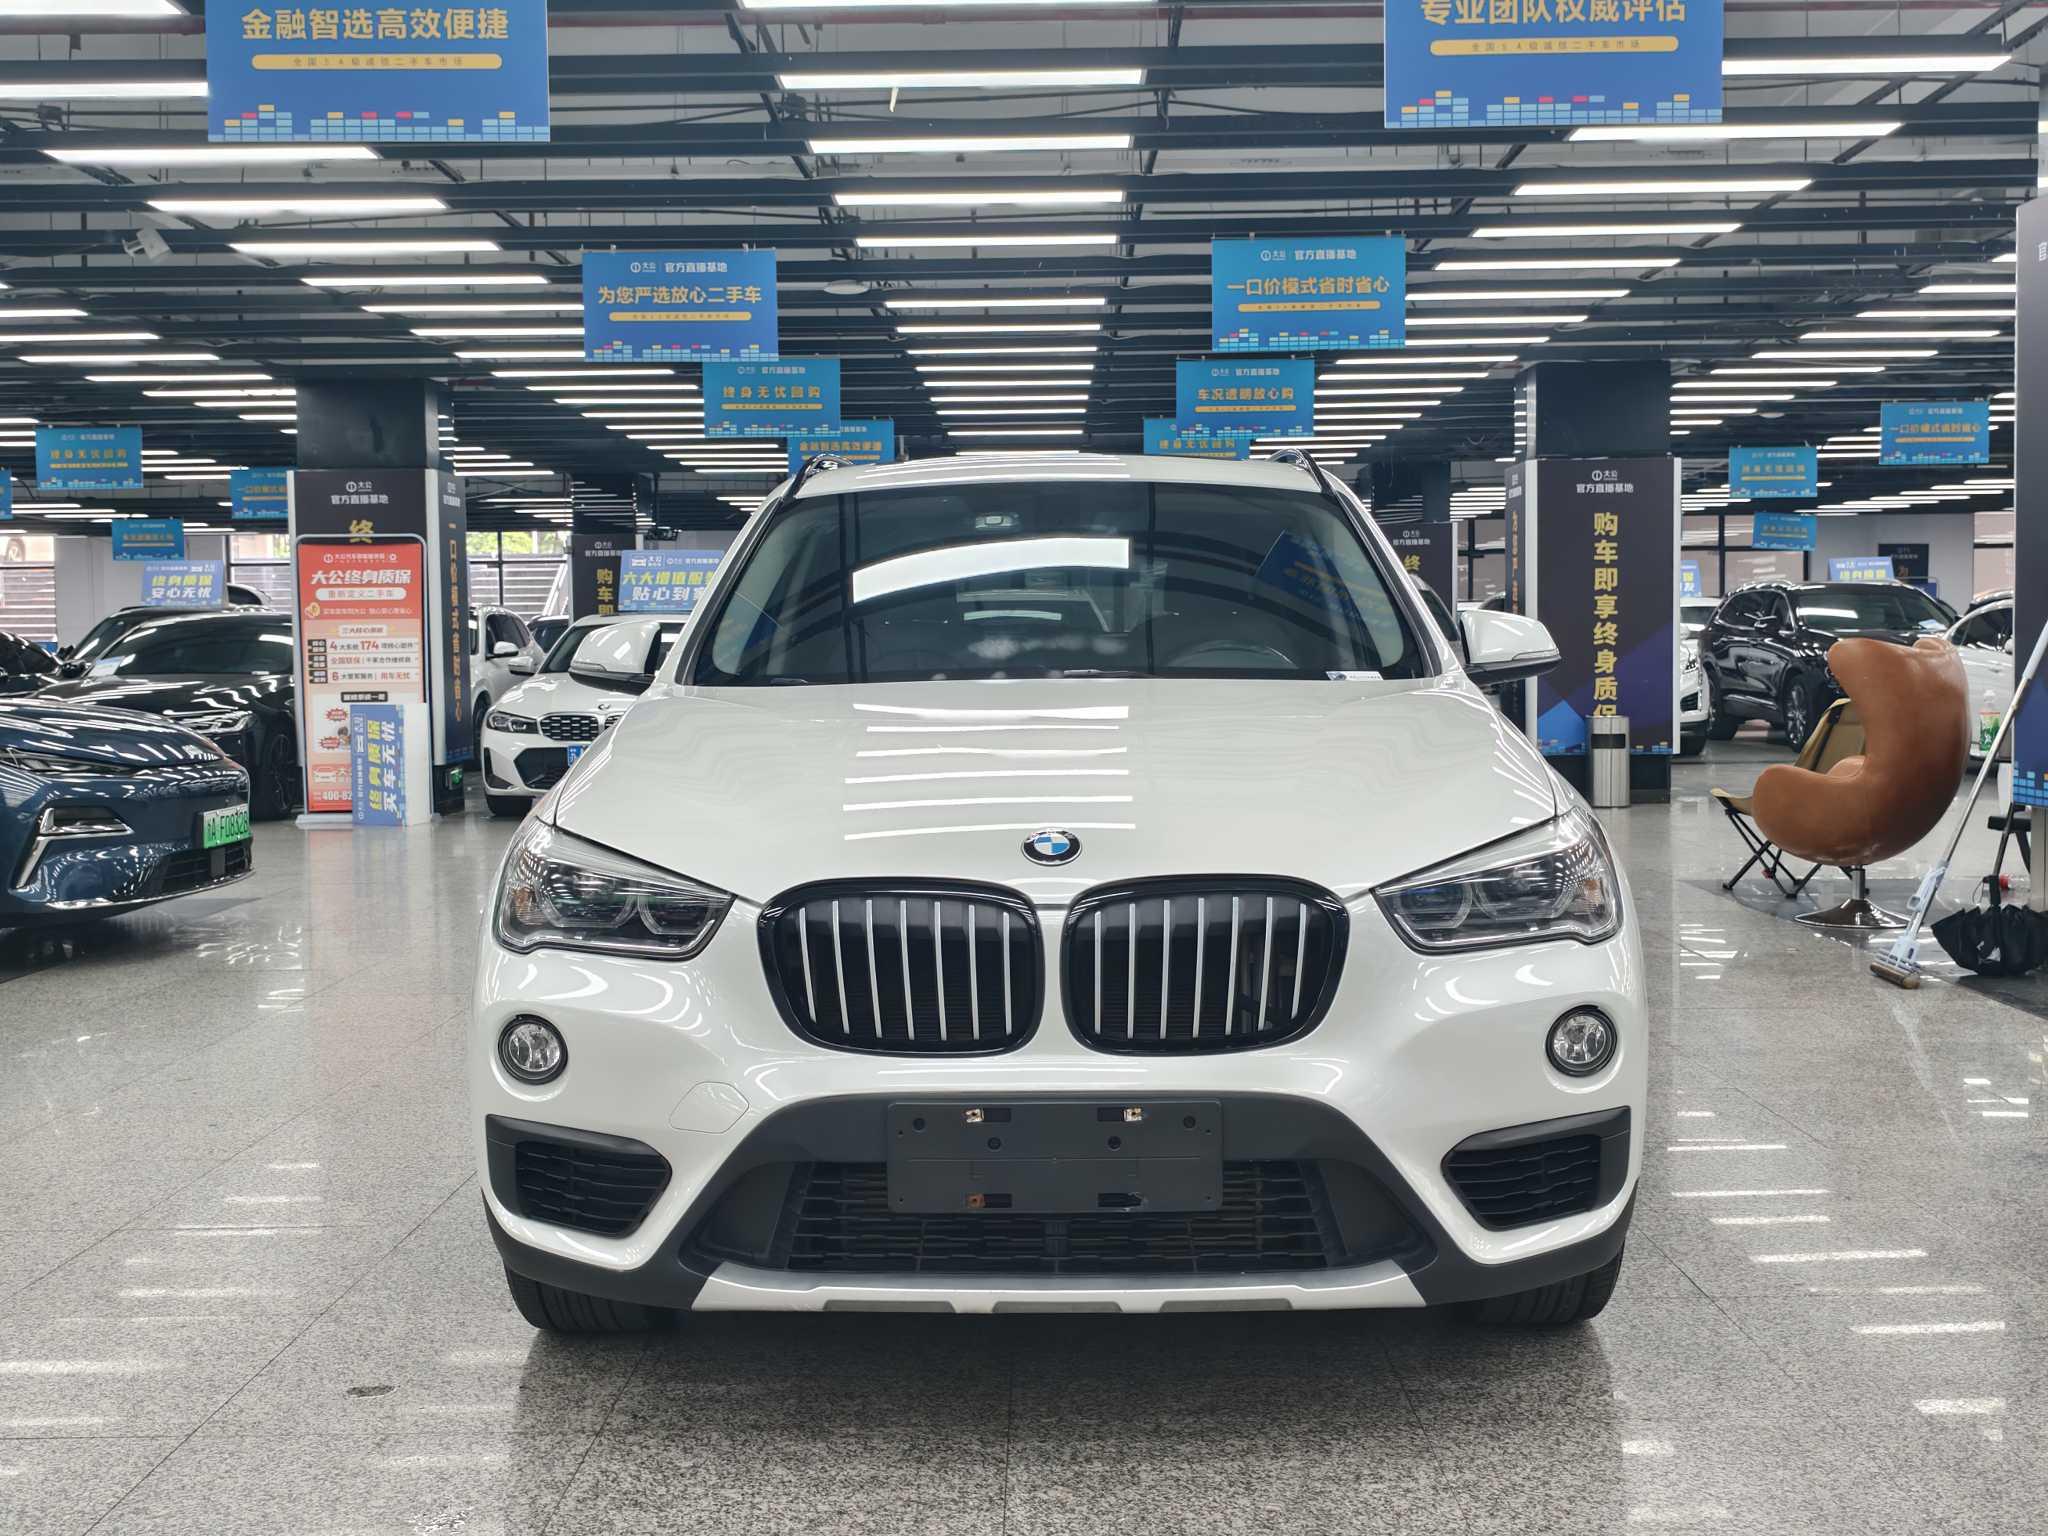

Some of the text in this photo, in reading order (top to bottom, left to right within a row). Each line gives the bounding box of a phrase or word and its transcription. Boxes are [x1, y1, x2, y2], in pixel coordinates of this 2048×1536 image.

[1420, 0, 1686, 25] 专业团队权威评估
[241, 8, 509, 40] 金融智选高效便捷
[664, 262, 728, 273] 官方直播基地
[1227, 276, 1390, 296] 一口价模式省时省心
[597, 286, 762, 304] 为您严选放心二手车
[1576, 483, 1634, 493] 官方直播基地
[330, 494, 389, 505] 官方直播基地
[310, 569, 412, 584] 大公终身质保
